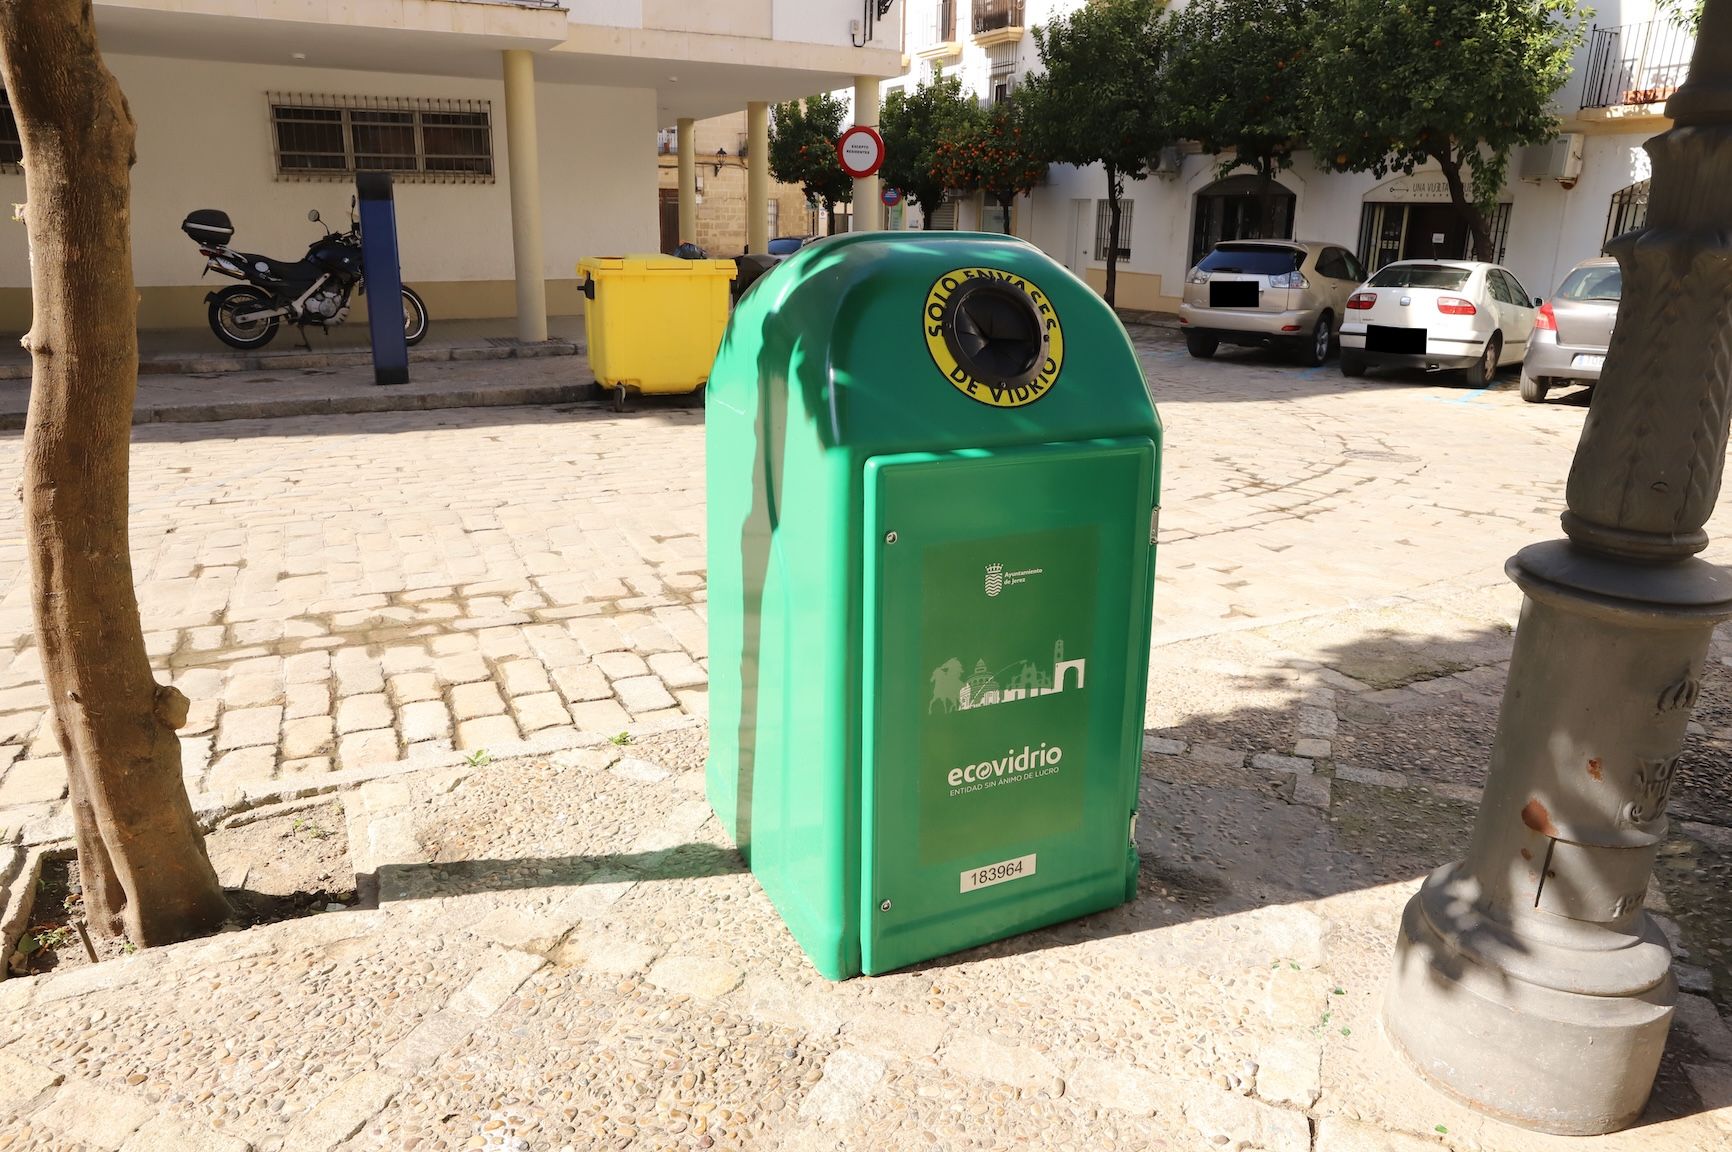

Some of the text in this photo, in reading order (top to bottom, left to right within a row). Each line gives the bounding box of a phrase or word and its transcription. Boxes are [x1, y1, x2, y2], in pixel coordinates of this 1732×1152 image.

[1412, 183, 1426, 193] UNA
[927, 269, 1057, 337] SOLO ENVASES
[950, 357, 1057, 403] DE VIDRIO
[1004, 568, 1043, 578] Ayuntamiento
[1011, 577, 1026, 585] Jerez
[947, 742, 1062, 786] ecovidrio
[949, 784, 983, 797] ENTIDAD
[984, 780, 997, 789] SIN
[1024, 771, 1034, 780] DE
[1034, 766, 1060, 778] LUCRO
[971, 860, 1024, 886] 183964
